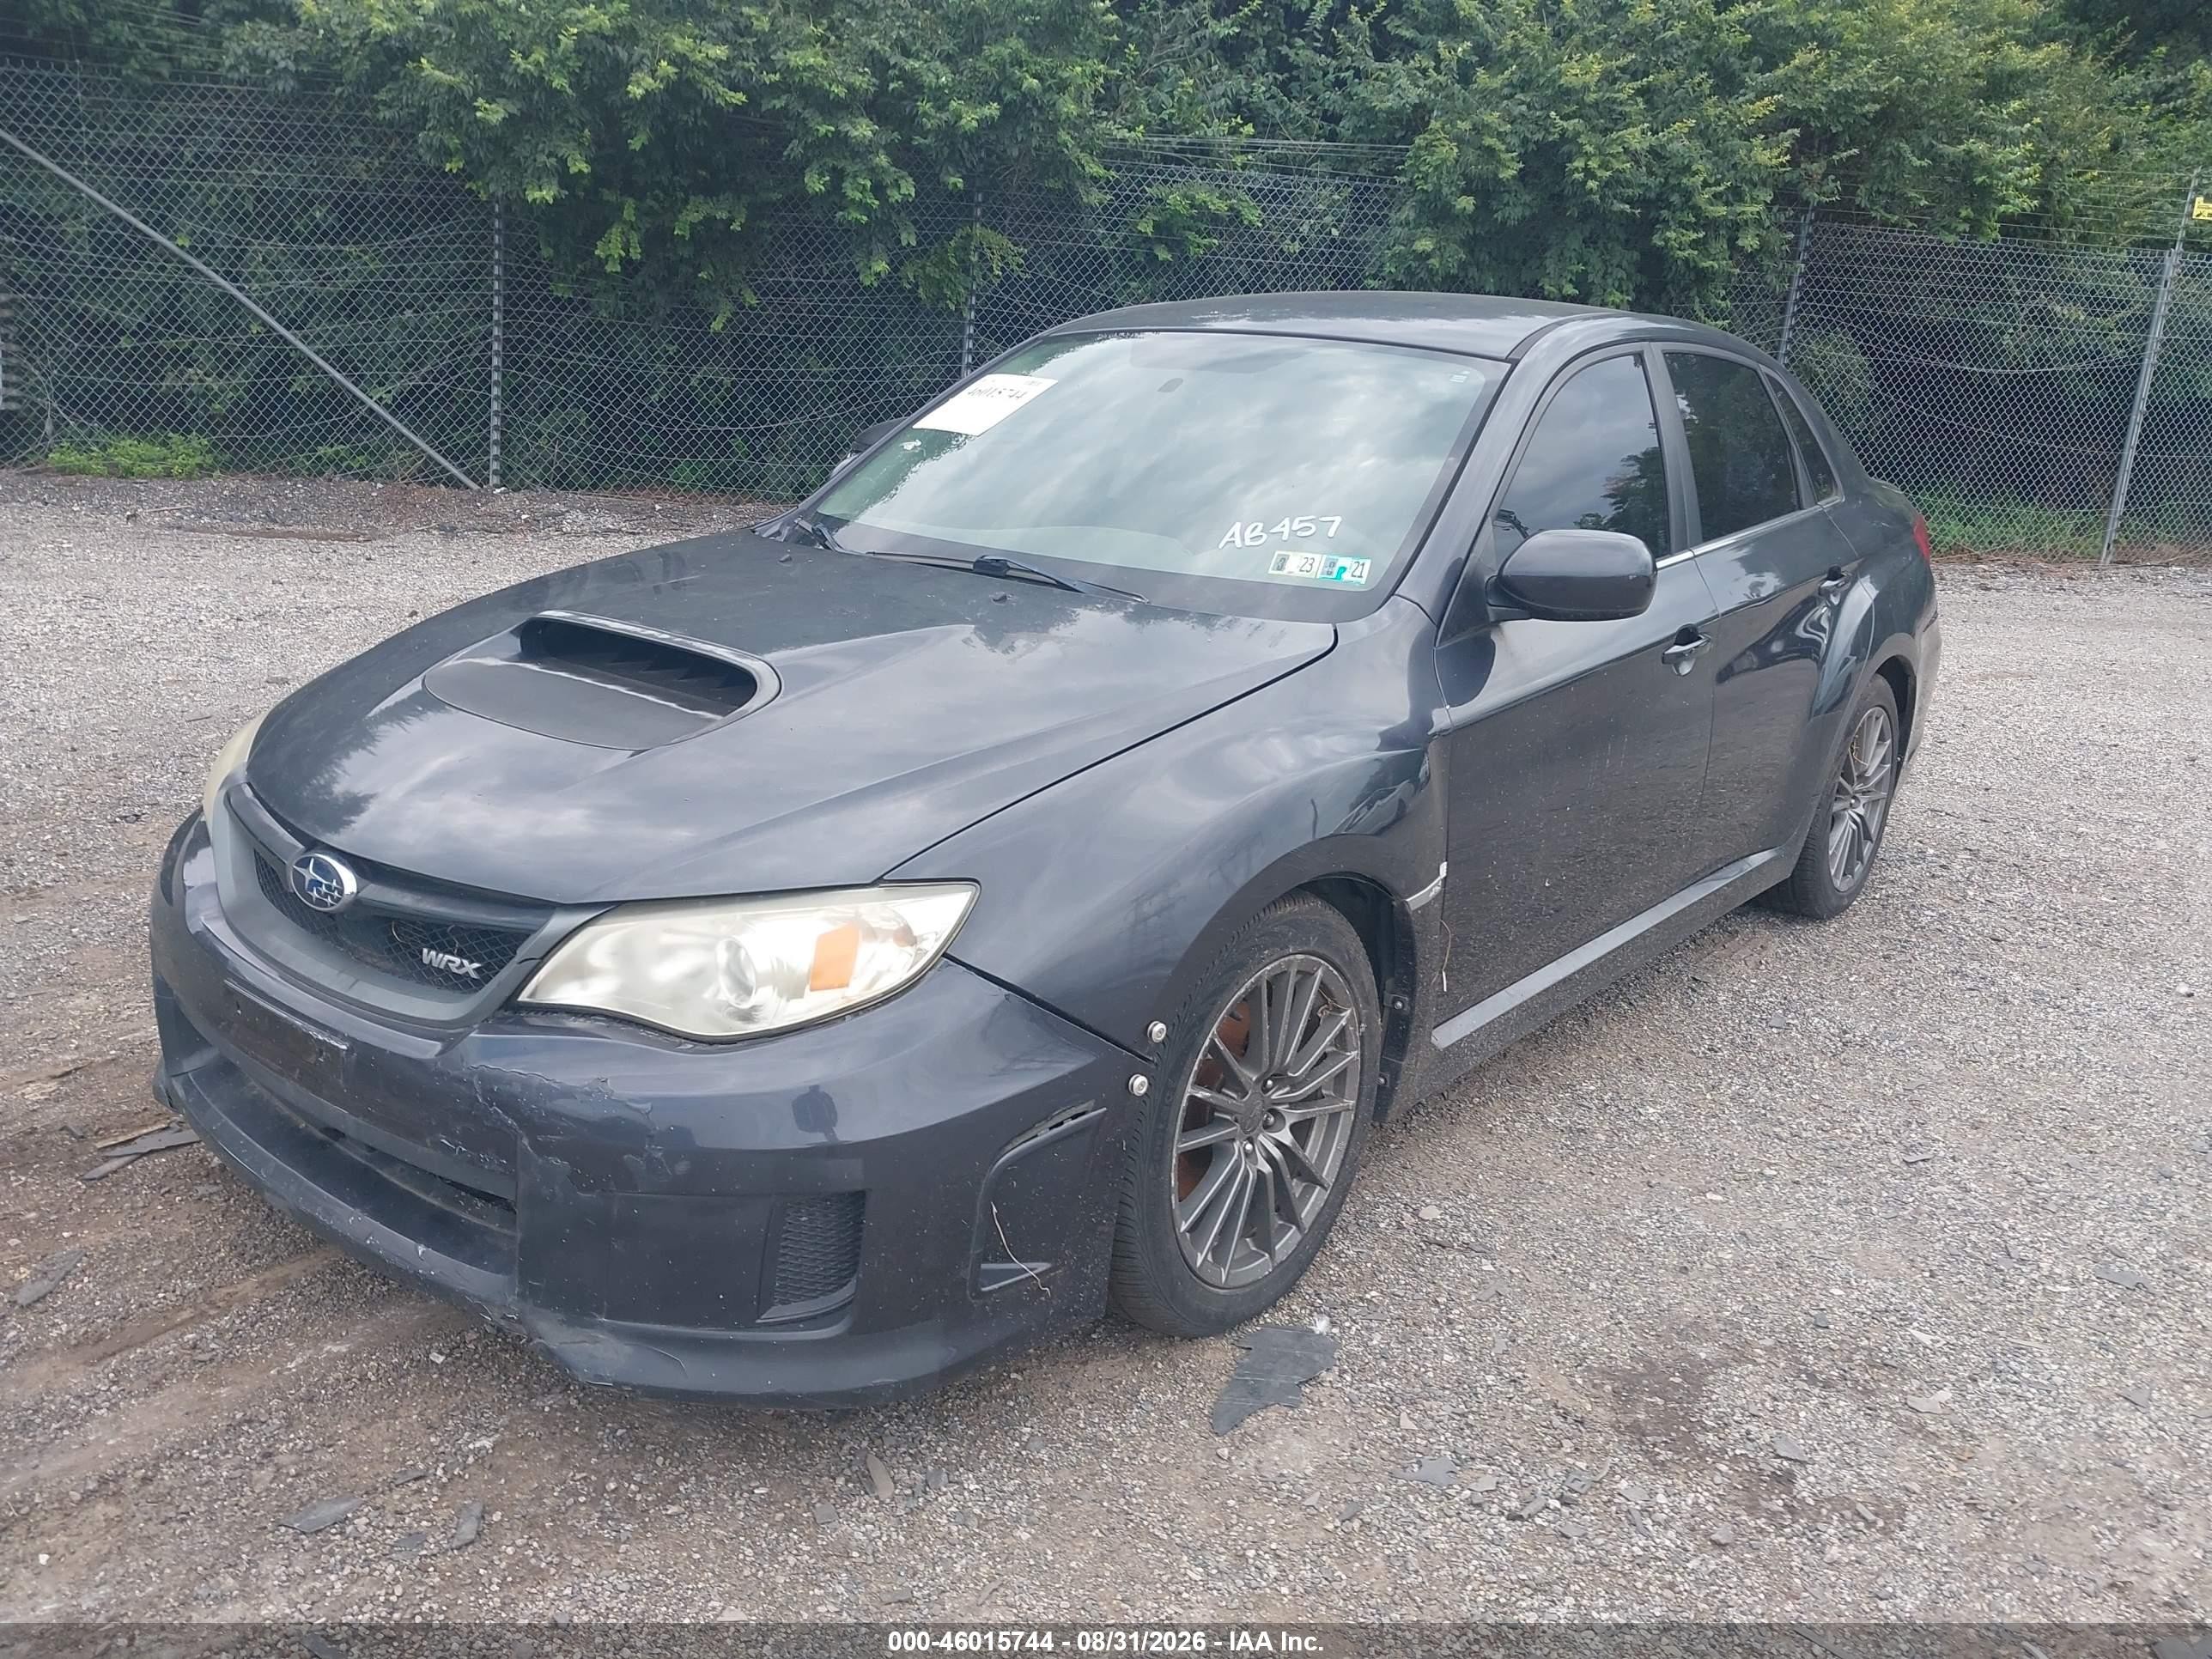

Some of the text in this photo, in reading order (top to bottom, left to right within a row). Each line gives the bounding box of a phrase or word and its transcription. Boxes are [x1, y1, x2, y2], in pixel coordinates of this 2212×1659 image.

[1299, 556, 1316, 574] 23
[1351, 561, 1365, 579] 21
[422, 947, 482, 979] WRX
